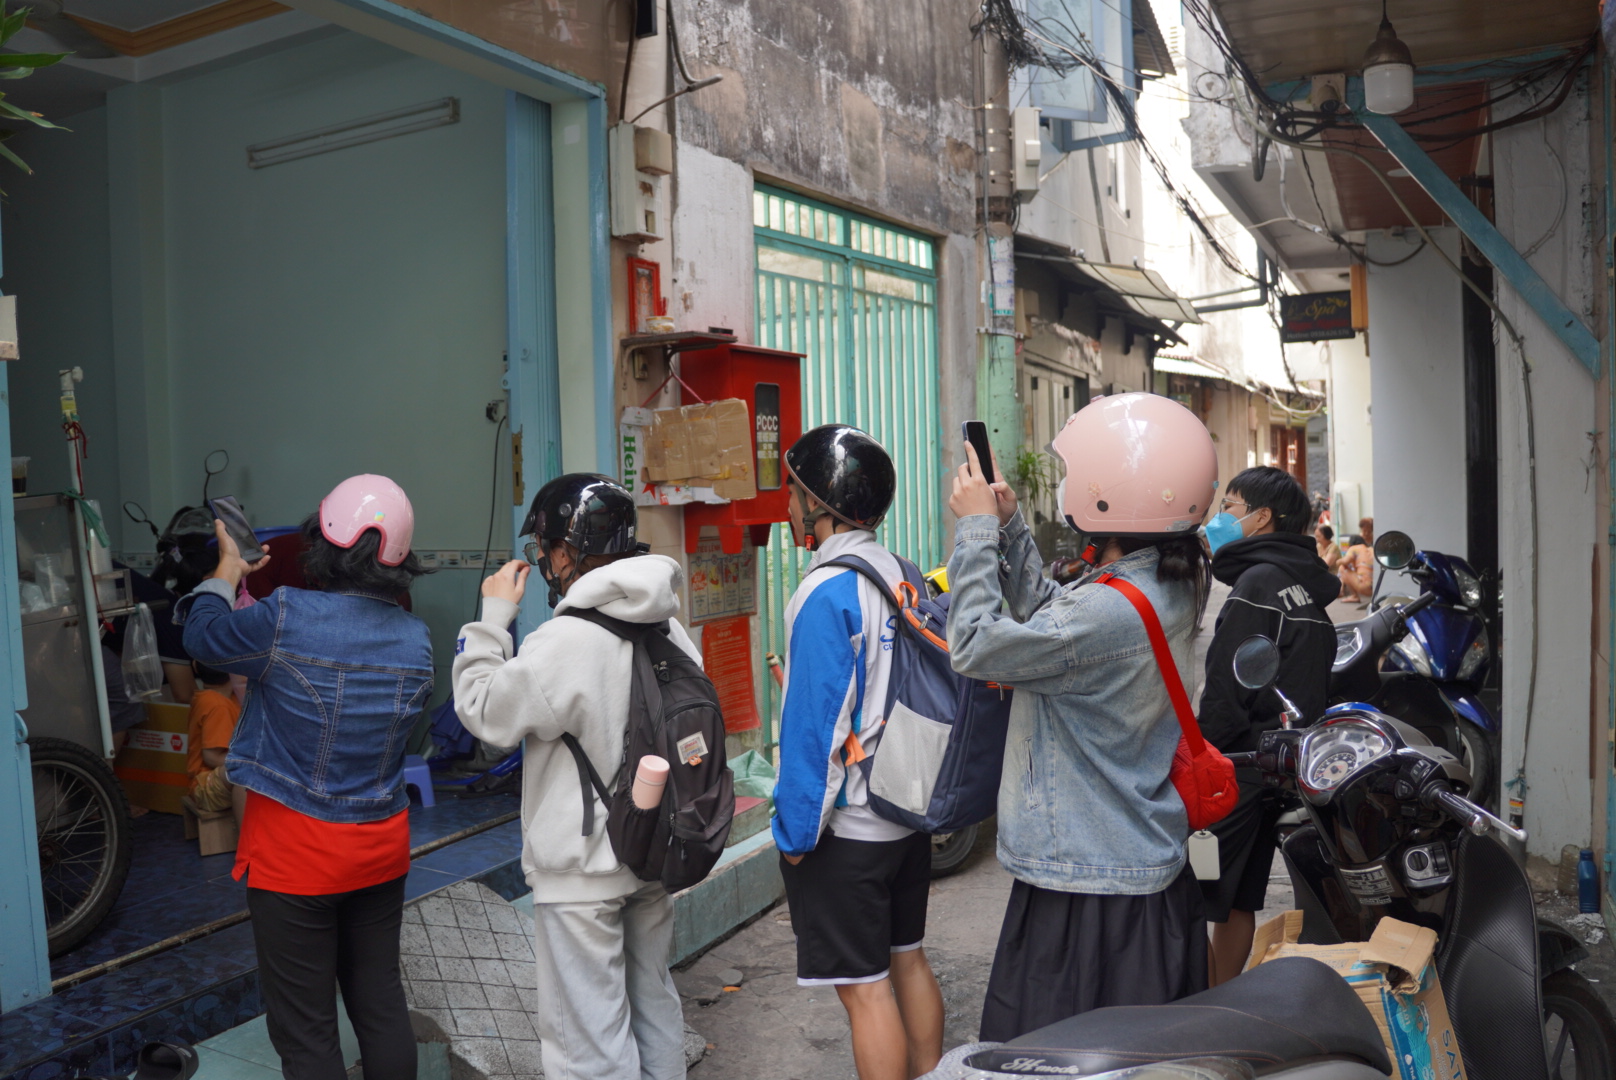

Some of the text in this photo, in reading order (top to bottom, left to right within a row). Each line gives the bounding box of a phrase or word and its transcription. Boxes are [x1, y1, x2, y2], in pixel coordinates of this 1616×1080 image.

[1305, 299, 1336, 320] Spa
[756, 415, 779, 431] PCCC
[623, 435, 637, 492] Hein
[1034, 1065, 1080, 1075] mode
